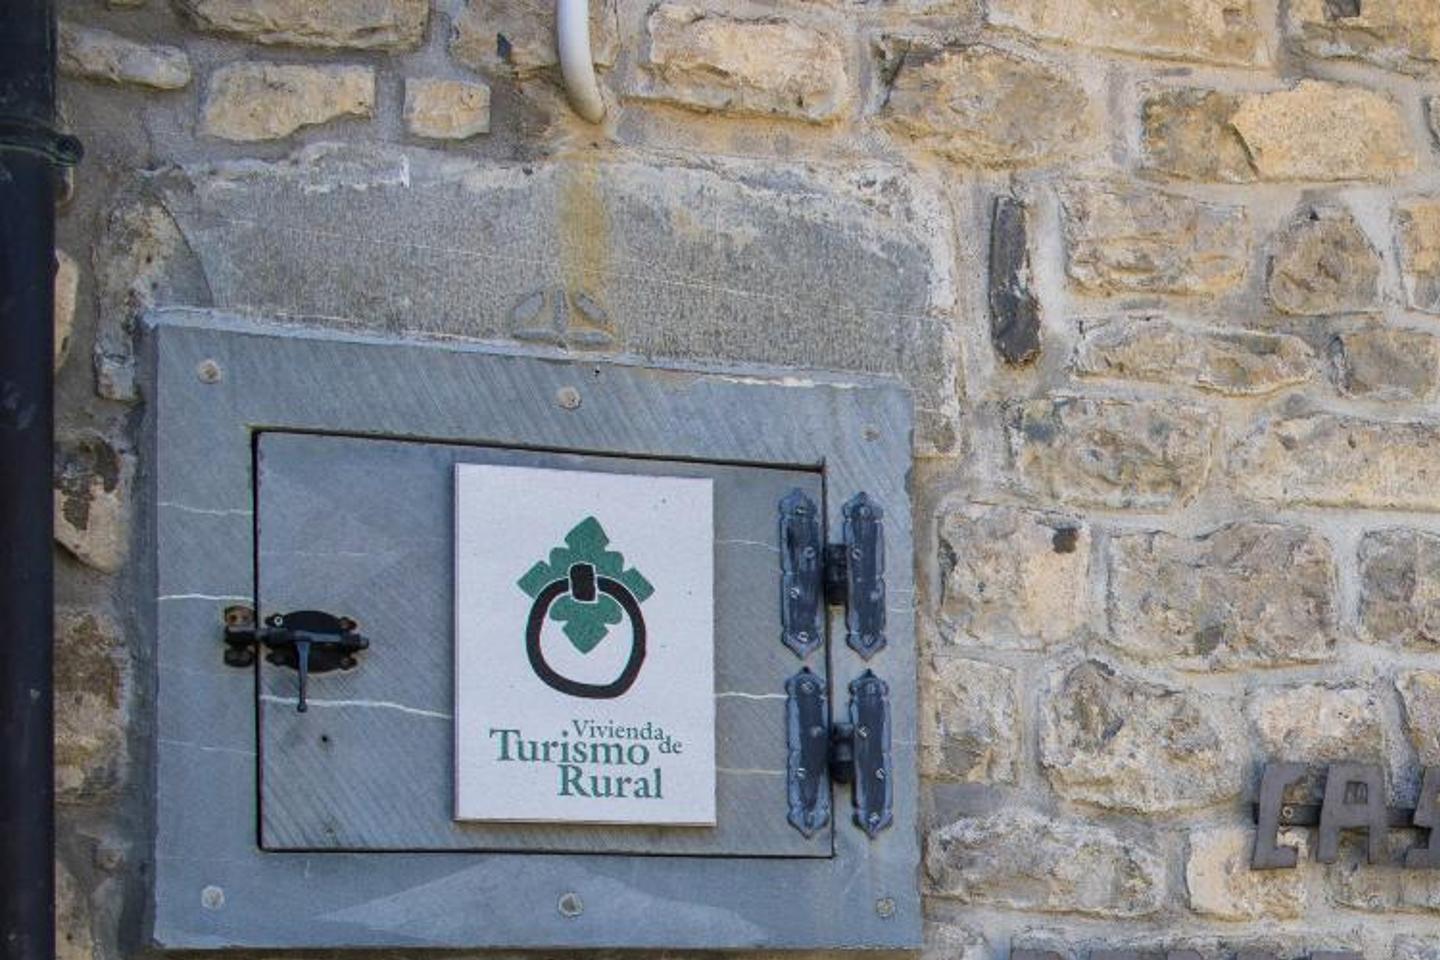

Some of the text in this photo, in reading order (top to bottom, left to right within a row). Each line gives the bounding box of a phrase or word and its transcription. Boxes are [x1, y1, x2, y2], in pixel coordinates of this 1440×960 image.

[489, 728, 651, 767] Turismo
[571, 719, 683, 755] Vivienda de
[557, 764, 665, 800] Rural
